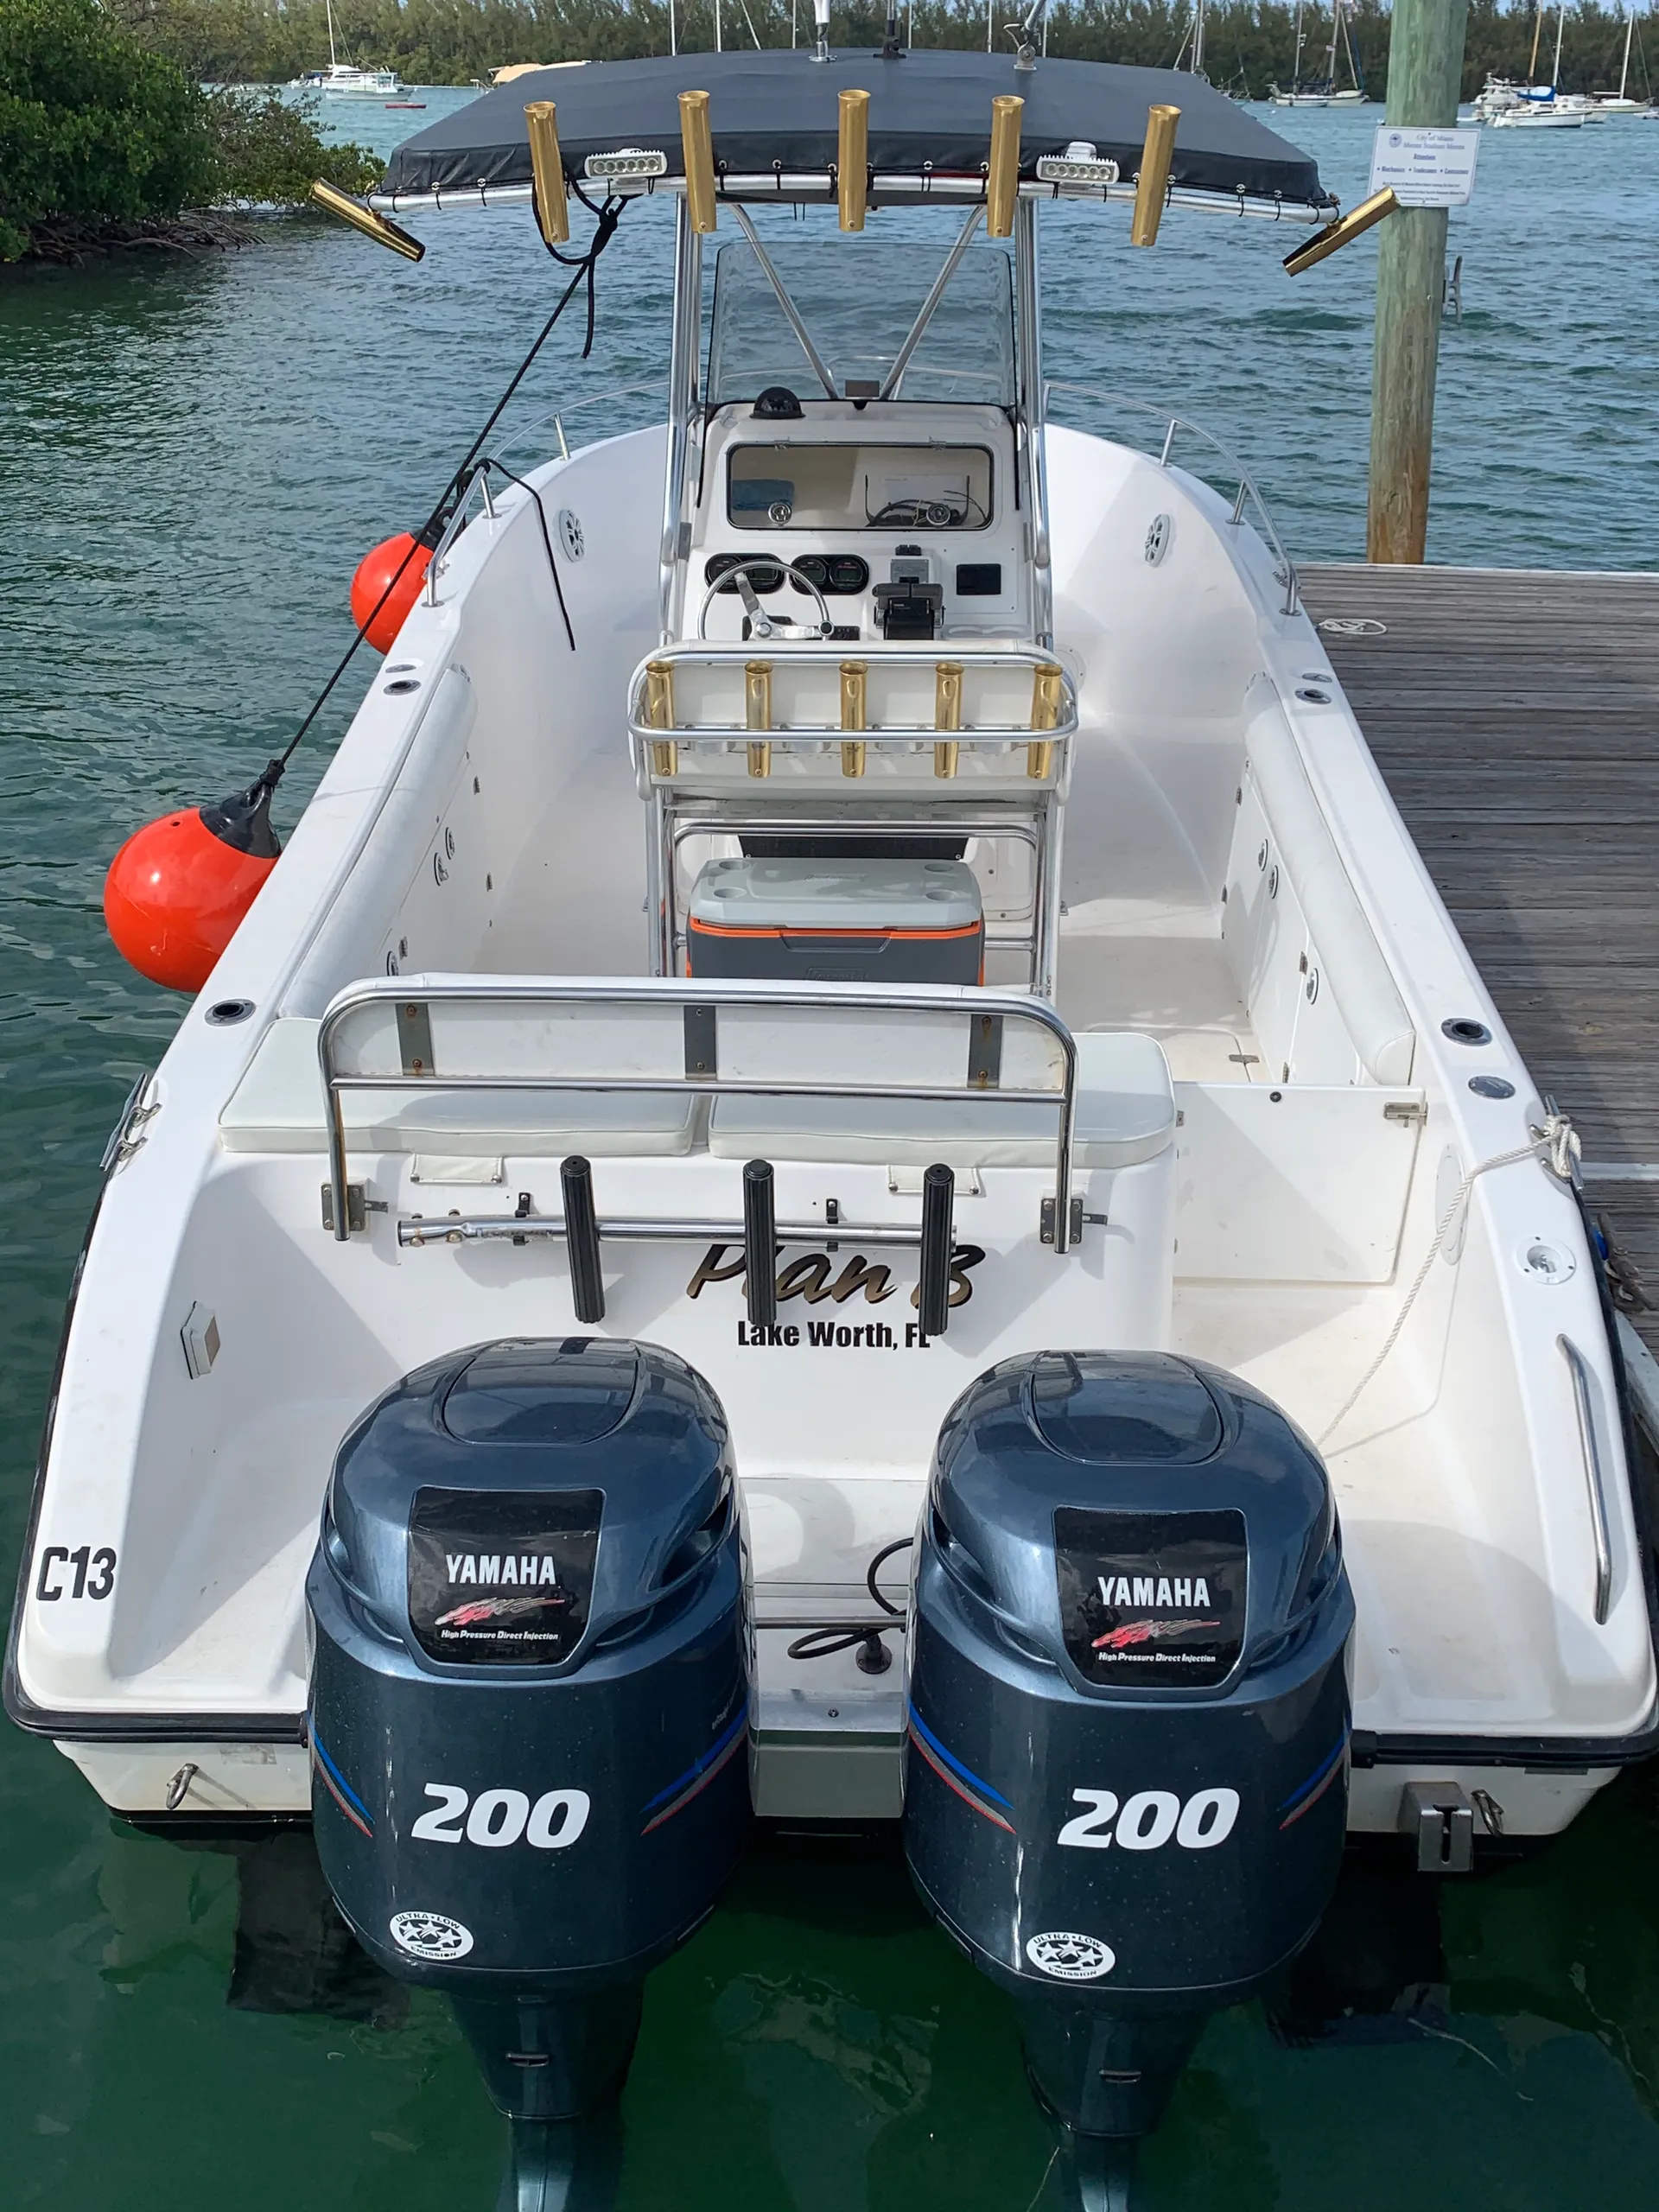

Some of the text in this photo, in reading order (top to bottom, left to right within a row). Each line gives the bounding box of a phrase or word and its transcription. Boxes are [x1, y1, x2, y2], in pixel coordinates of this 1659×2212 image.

[686, 1244, 899, 1305] Pan
[738, 1321, 799, 1346] Lake
[807, 1322, 898, 1351] Worth,
[35, 1546, 117, 1601] C13
[446, 1554, 556, 1585] YAMAHA
[1097, 1576, 1211, 1607] YAMAHA
[441, 1630, 559, 1641] High Pressure Direct Injection
[1098, 1652, 1216, 1663] High Pressure Direct Injection
[410, 1783, 591, 1848] 200
[1057, 1788, 1240, 1850] 200
[410, 1945, 457, 1958] EMISSION
[1048, 1966, 1097, 1977] EMISSION
